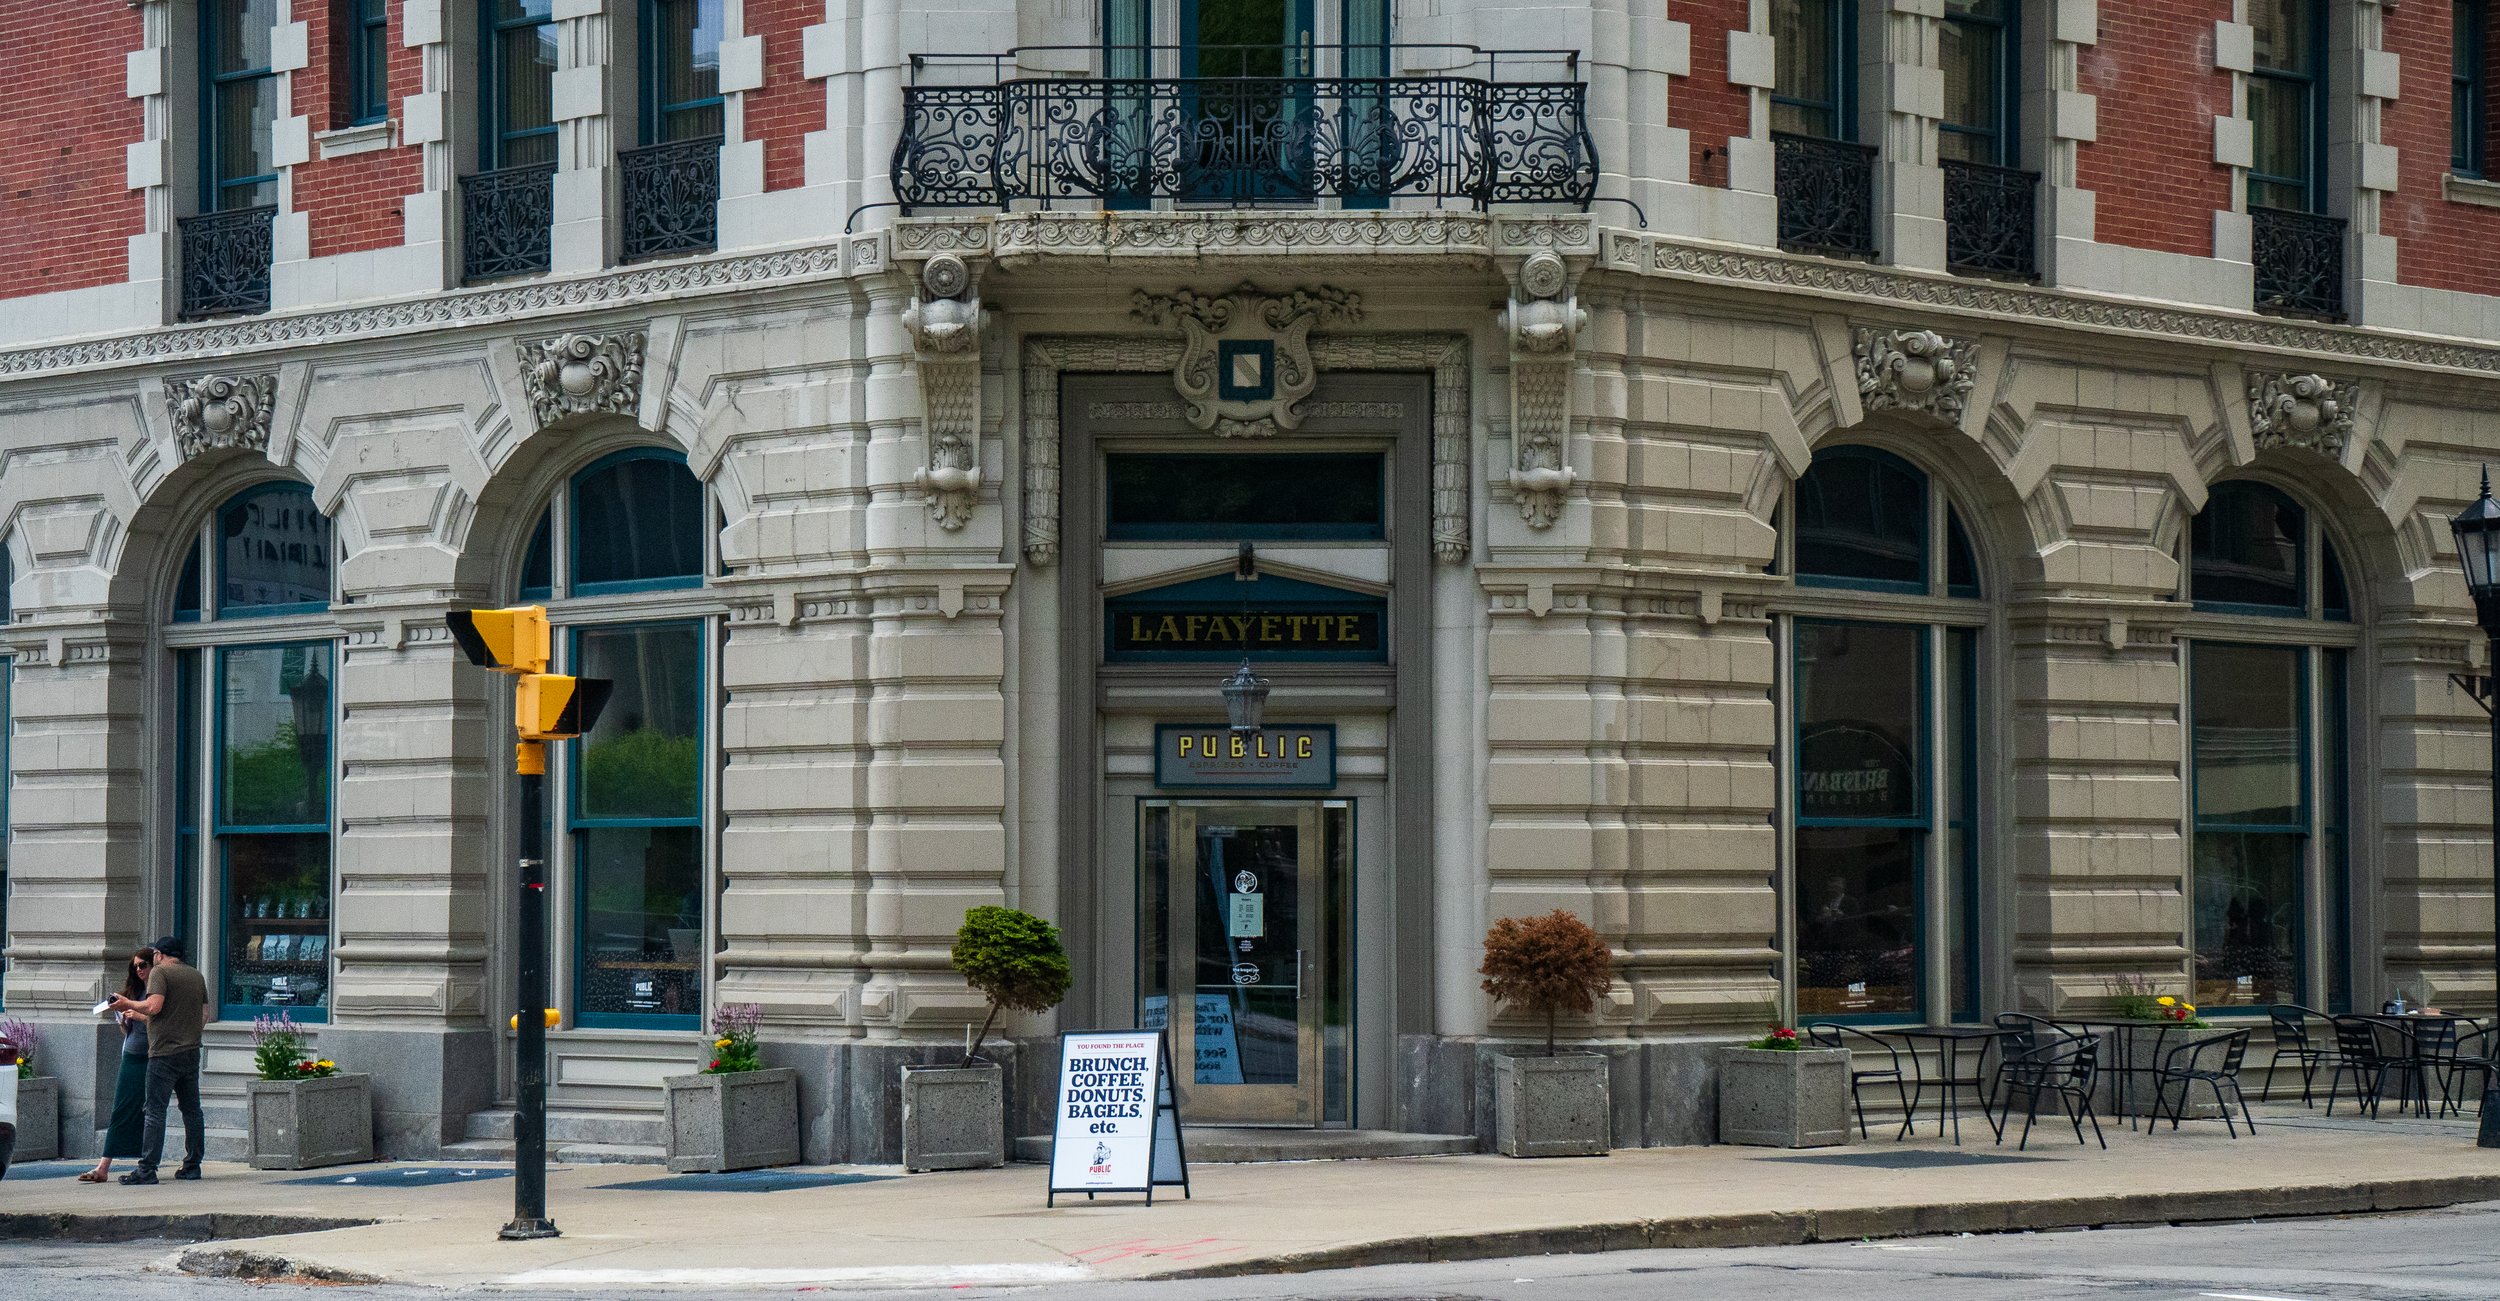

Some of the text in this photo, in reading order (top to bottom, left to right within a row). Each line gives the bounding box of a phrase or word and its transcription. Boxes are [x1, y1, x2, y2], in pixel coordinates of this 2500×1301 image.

[1130, 615, 1360, 642] LAFAYETTE
[1178, 735, 1313, 759] PUBLIC
[1258, 761, 1299, 769] COFFEE
[635, 981, 653, 991] PUBLIC
[1068, 1057, 1149, 1073] BRUNCH,
[1071, 1072, 1145, 1088] COFFEE,
[1066, 1088, 1146, 1103] DONUTS,
[1067, 1103, 1143, 1119] BAGELS,
[1089, 1121, 1119, 1134] etc.
[1089, 1164, 1111, 1173] PUBLIC
